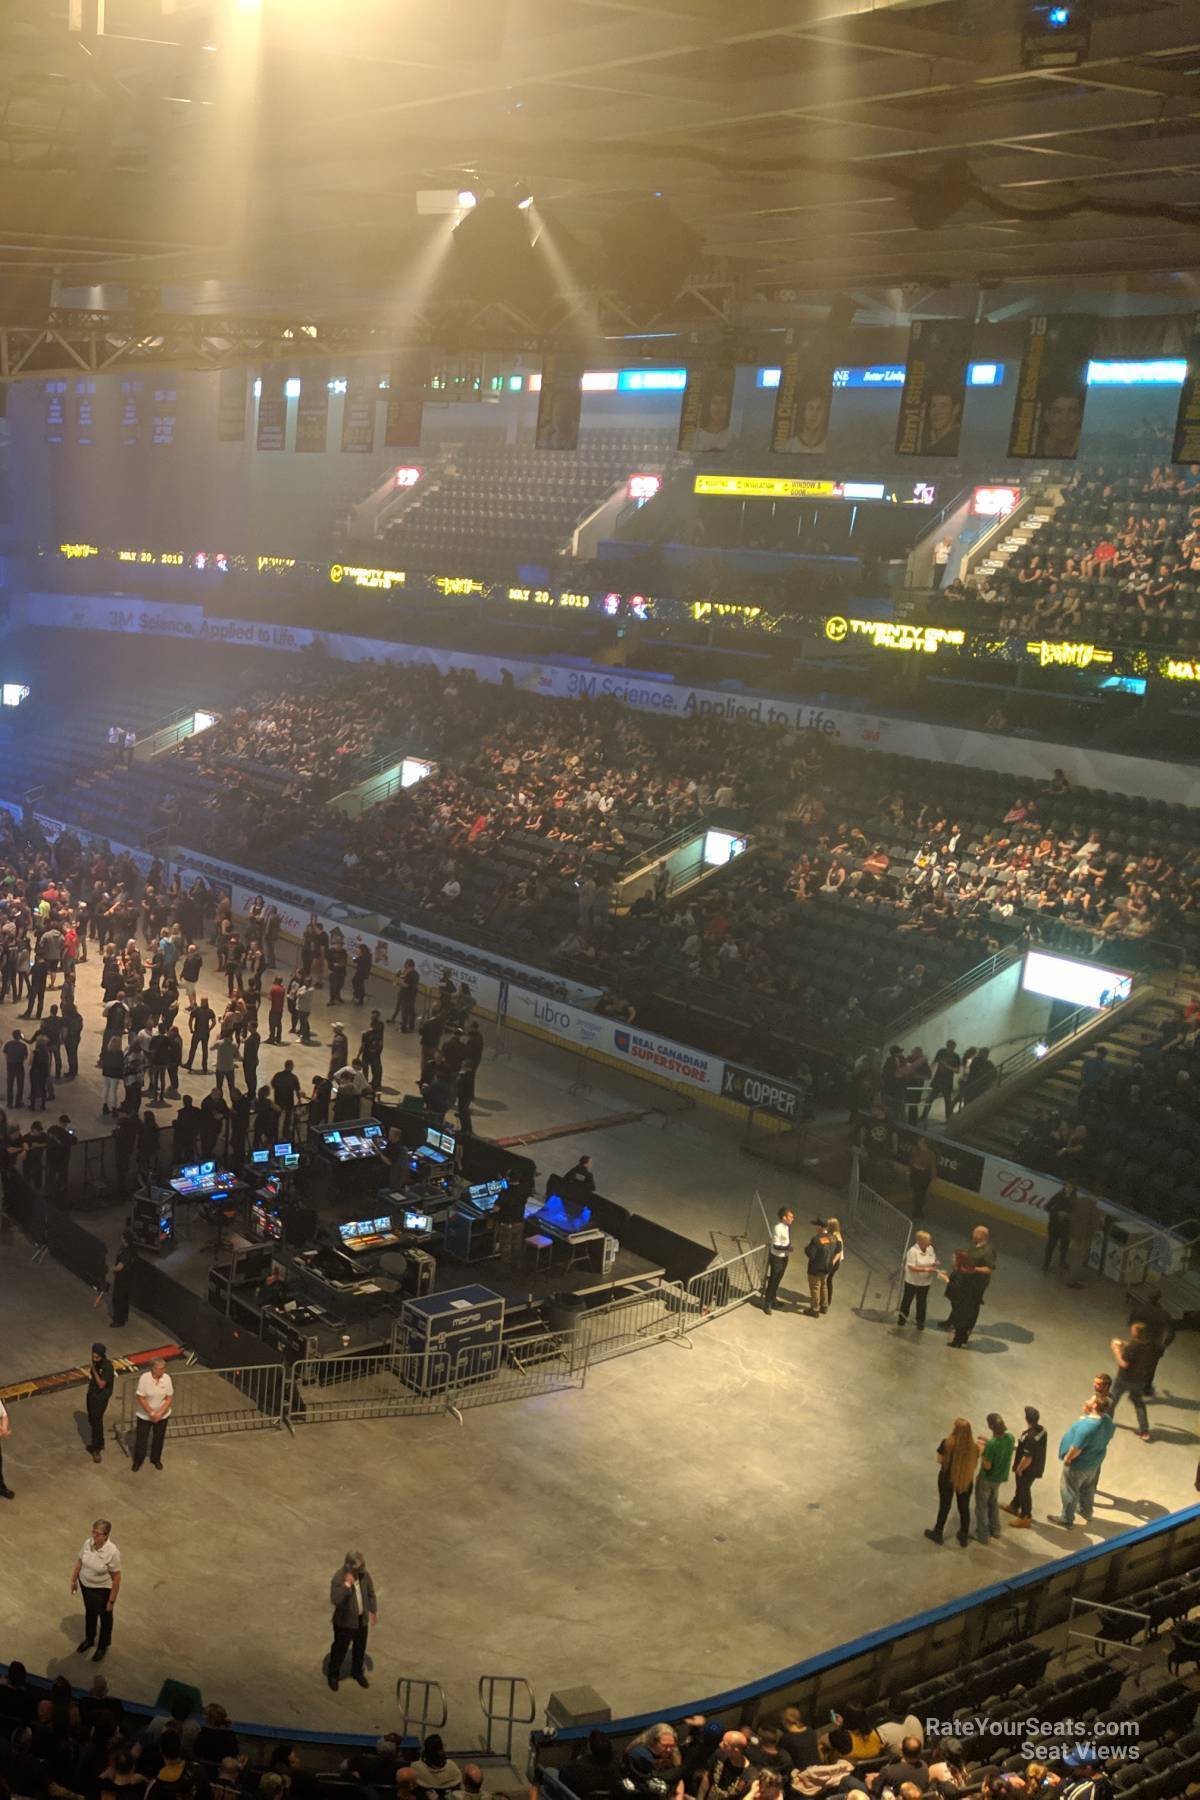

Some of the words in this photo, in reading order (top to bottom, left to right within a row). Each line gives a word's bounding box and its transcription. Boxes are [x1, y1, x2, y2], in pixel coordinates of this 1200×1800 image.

[1030, 316, 1048, 336] 19
[161, 554, 184, 565] 2019
[509, 588, 531, 600] MAY
[535, 590, 555, 606] 20,
[561, 593, 590, 608] 2019
[200, 619, 254, 641] Applied
[258, 628, 269, 642] to
[273, 627, 298, 647] Life.
[850, 619, 923, 640] TWENTY
[874, 633, 938, 653] PILOTS
[566, 673, 597, 696] 3M
[601, 677, 678, 712] Science.
[768, 704, 789, 729] to
[795, 705, 841, 738] Life.
[533, 998, 571, 1029] Libro
[632, 1035, 655, 1052] REAL
[657, 1042, 709, 1071] CANADIAN
[724, 1070, 736, 1093] X
[743, 1078, 797, 1116] COPPER
